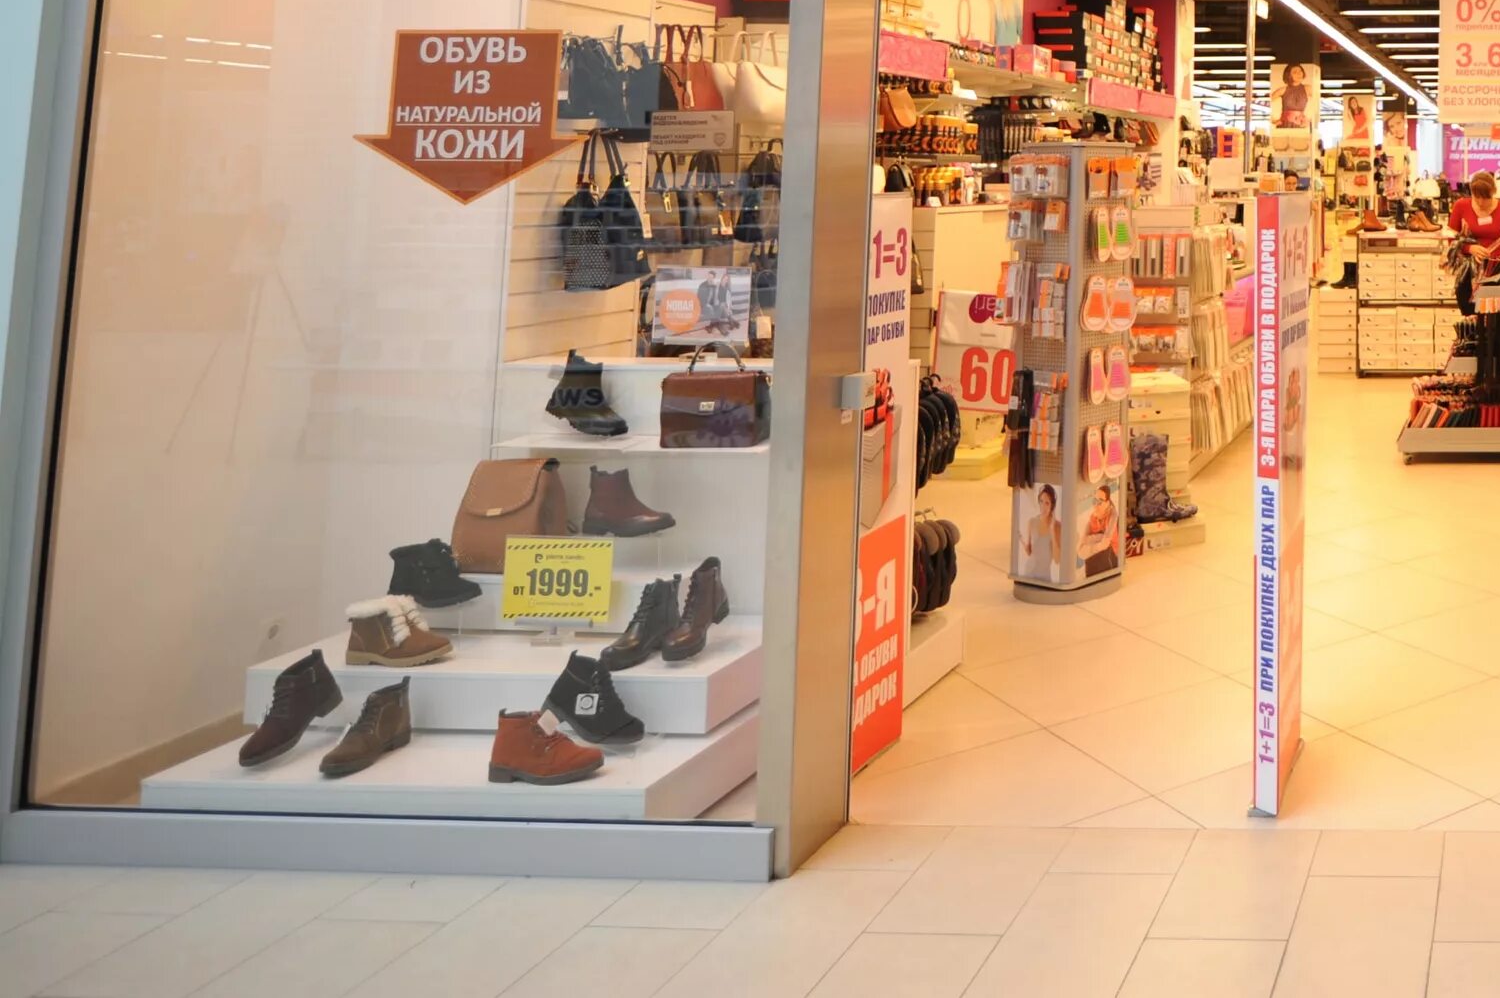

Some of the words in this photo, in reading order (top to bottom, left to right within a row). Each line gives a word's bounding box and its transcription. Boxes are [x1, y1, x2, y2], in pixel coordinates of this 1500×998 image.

[419, 36, 527, 64] ОБУВЬ
[1456, 42, 1472, 68] 3
[454, 70, 491, 94] ИЗ
[395, 101, 542, 124] НАТУРАЛЬНОЙ
[1443, 97, 1465, 106] БЕЗ
[415, 129, 526, 159] КОЖИ
[1261, 228, 1277, 310] ПОДАРОК
[881, 320, 905, 342] ОБУВИ
[1261, 313, 1276, 326] В
[1261, 328, 1276, 386] ОБУВИ
[960, 347, 1016, 404] 60
[1261, 388, 1276, 434] ПАРА
[1261, 436, 1276, 467] 3-Я
[1261, 485, 1277, 519] ПАР
[1261, 523, 1277, 571] ДВУХ
[526, 568, 601, 597] 1999.-
[1260, 575, 1275, 653] ПОКУПКЕ
[860, 633, 898, 682] ОБУВИ
[1260, 656, 1275, 692] ПРИ
[1259, 702, 1275, 764] 1+1=3
